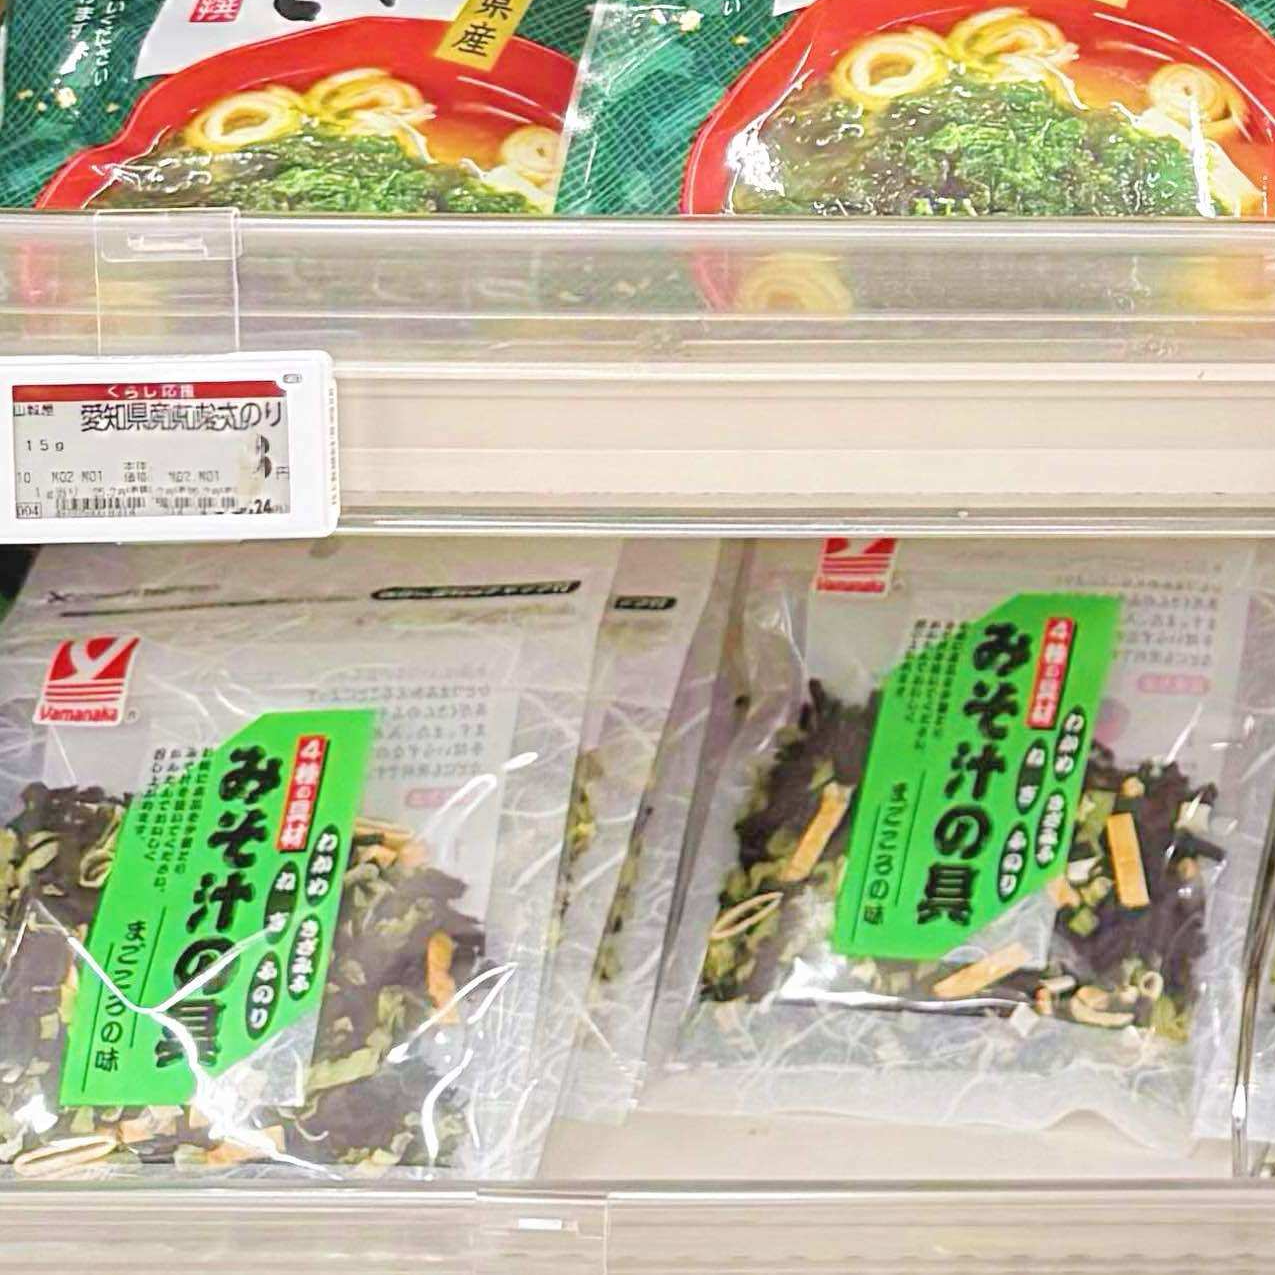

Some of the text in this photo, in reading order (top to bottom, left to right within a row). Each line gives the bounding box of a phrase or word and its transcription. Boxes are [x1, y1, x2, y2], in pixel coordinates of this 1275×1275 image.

[40, 704, 118, 723] Yamanaka
[916, 621, 1032, 925] みそ汁の具
[155, 744, 283, 1070] みそ汁の具
